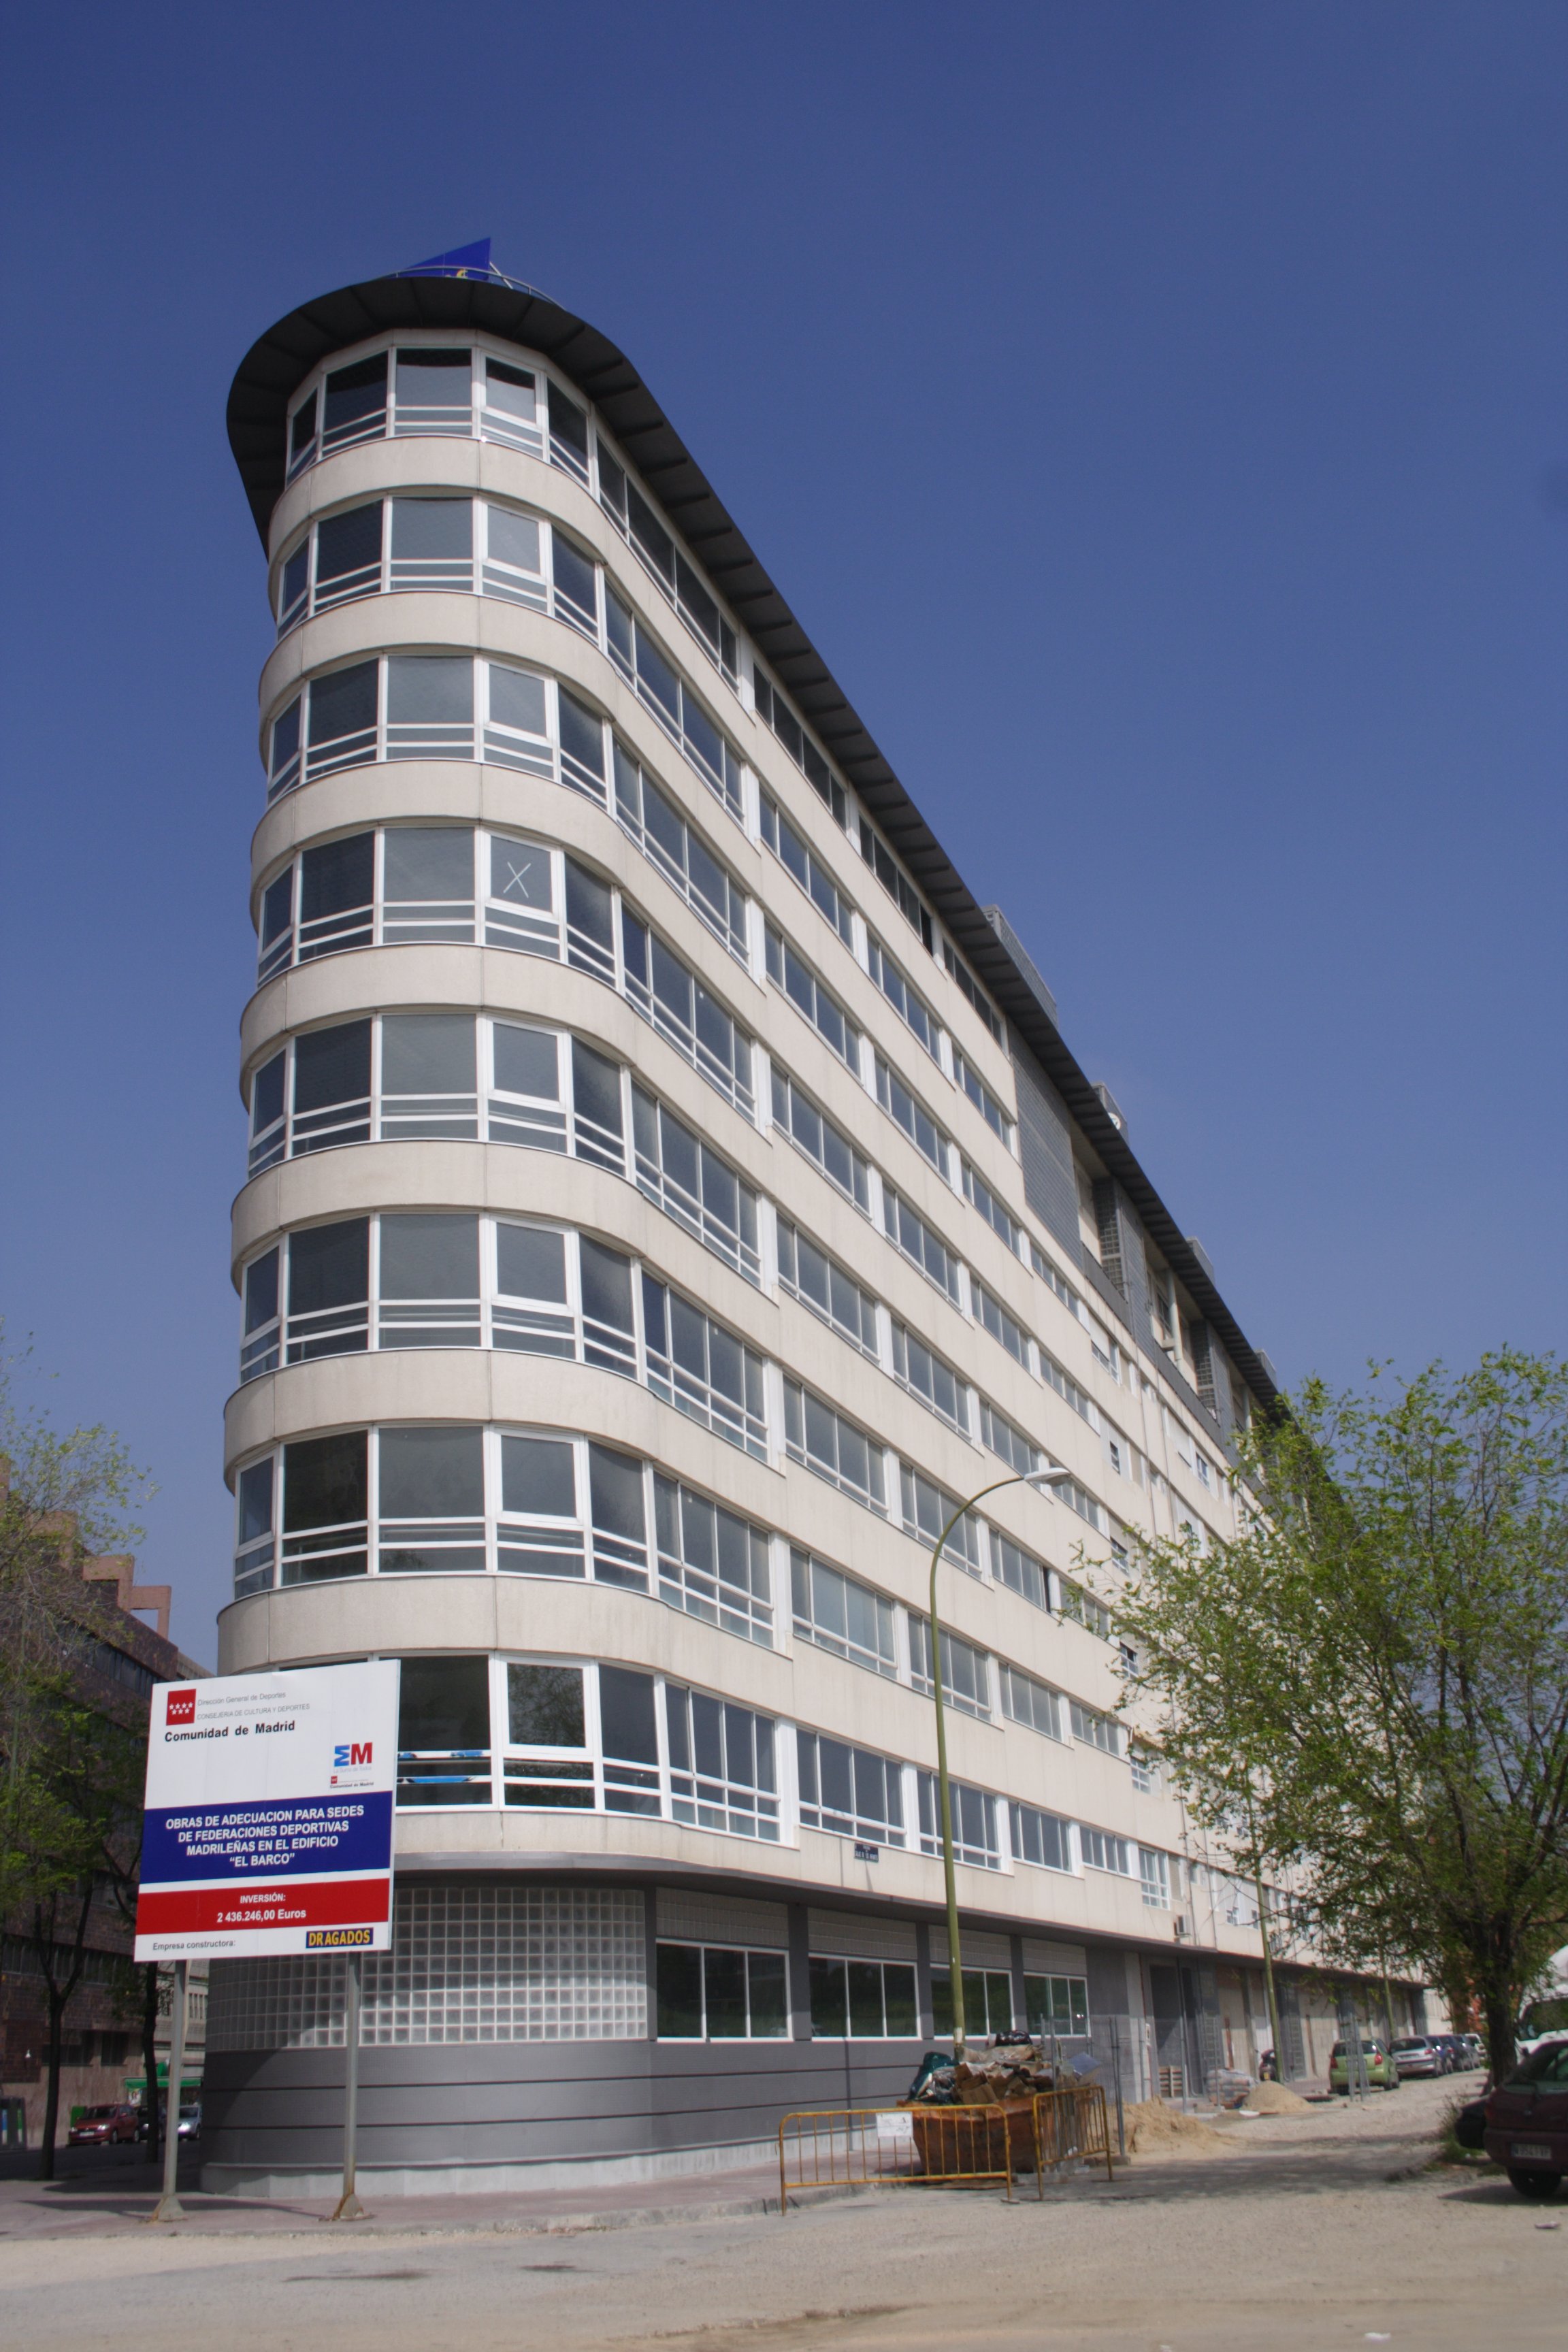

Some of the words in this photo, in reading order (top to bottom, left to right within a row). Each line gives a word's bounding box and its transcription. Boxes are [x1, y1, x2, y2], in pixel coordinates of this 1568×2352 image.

[226, 1695, 250, 1703] General
[259, 1692, 286, 1700] Deportes
[244, 1707, 271, 1716] CULTURA
[277, 1703, 310, 1712] DEPORTES
[165, 1726, 229, 1742] Comunidad
[235, 1725, 249, 1735] de
[255, 1720, 295, 1734] Madrid
[165, 1816, 203, 1830] OBRAS
[205, 1815, 220, 1827] DE
[221, 1810, 293, 1825] ADECUACION
[295, 1808, 325, 1820] PARA
[327, 1804, 365, 1818] SEDES
[178, 1831, 193, 1843] DE
[195, 1825, 278, 1842] FEDERACIONES
[280, 1820, 350, 1836] DEPORTIVAS
[186, 1840, 256, 1857] MADRILEÑAS
[258, 1840, 273, 1851] EN
[275, 1839, 290, 1850] EL
[291, 1835, 339, 1850] EDIFICIO
[239, 1892, 287, 1904] INVERSIÓN:
[277, 1908, 307, 1920] Euros
[308, 1929, 371, 1947] DRAGADOS
[152, 1942, 185, 1952] Empresa
[186, 1940, 236, 1949] constructora:
